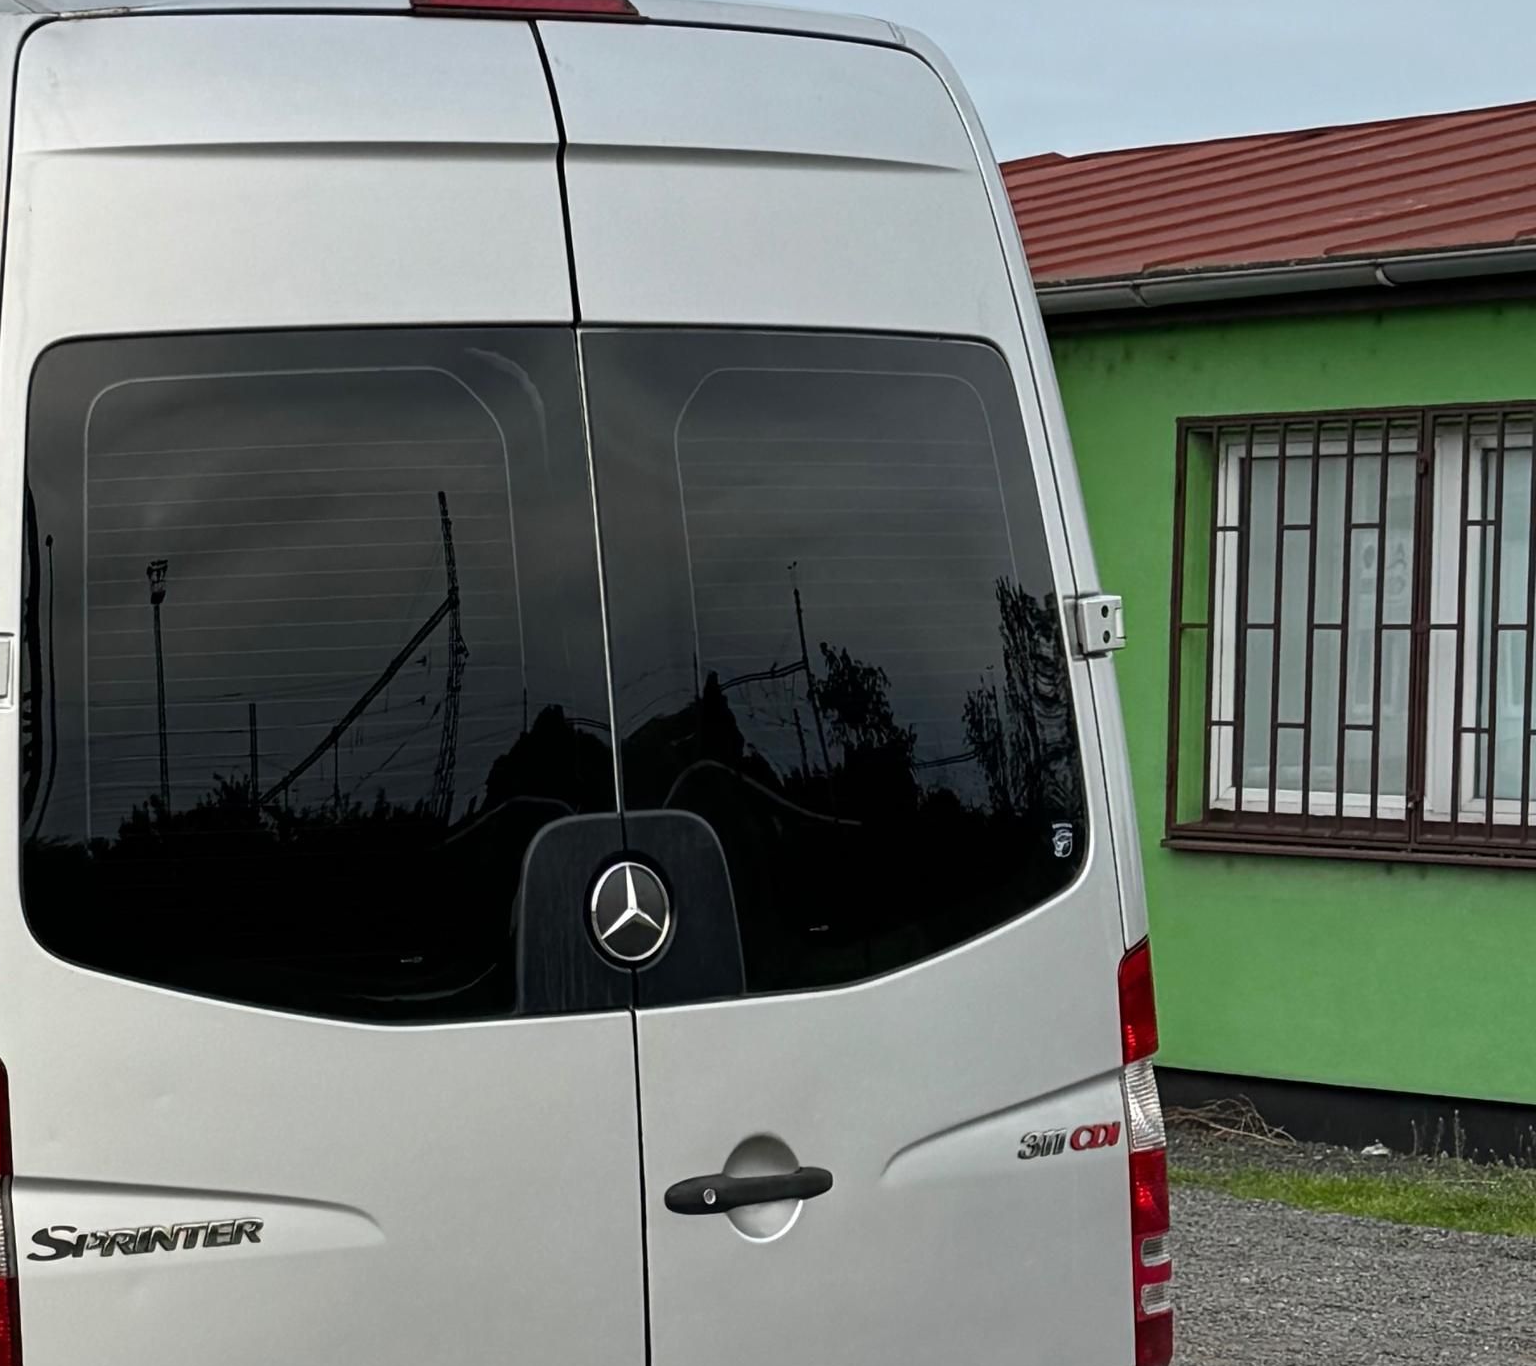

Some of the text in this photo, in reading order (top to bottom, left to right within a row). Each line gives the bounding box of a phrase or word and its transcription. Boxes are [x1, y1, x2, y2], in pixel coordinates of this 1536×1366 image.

[1017, 1121, 1121, 1160] 311 CDI
[26, 1217, 265, 1262] SPRINTER
